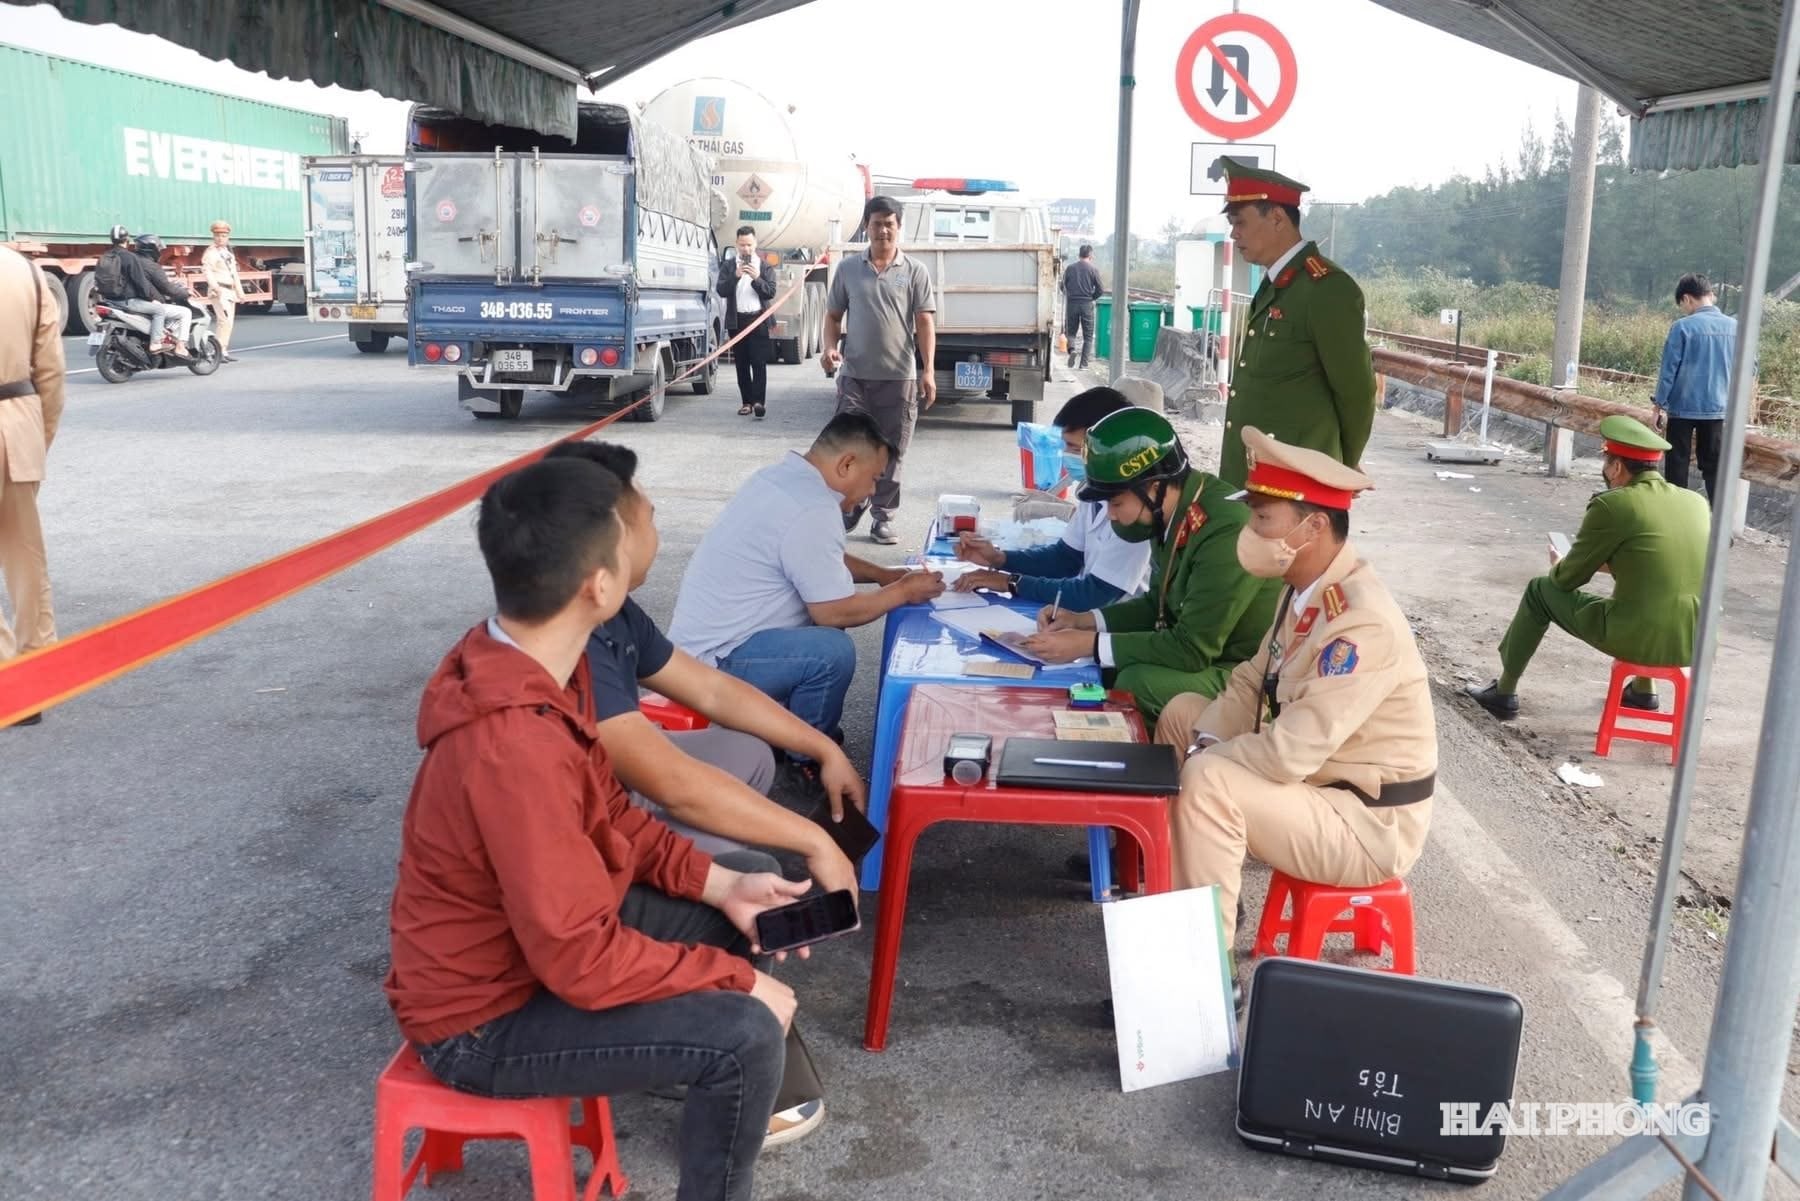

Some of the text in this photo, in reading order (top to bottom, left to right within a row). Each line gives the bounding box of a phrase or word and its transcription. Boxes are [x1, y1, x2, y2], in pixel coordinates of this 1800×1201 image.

[723, 141, 744, 155] GAS
[123, 127, 300, 191] EVERGREEN
[432, 301, 609, 319] THACO 34B-036.55 FRONTIER
[504, 351, 522, 360] 34B
[964, 364, 983, 376] 34A
[1119, 446, 1160, 477] CSTT
[1358, 1069, 1370, 1086] 5
